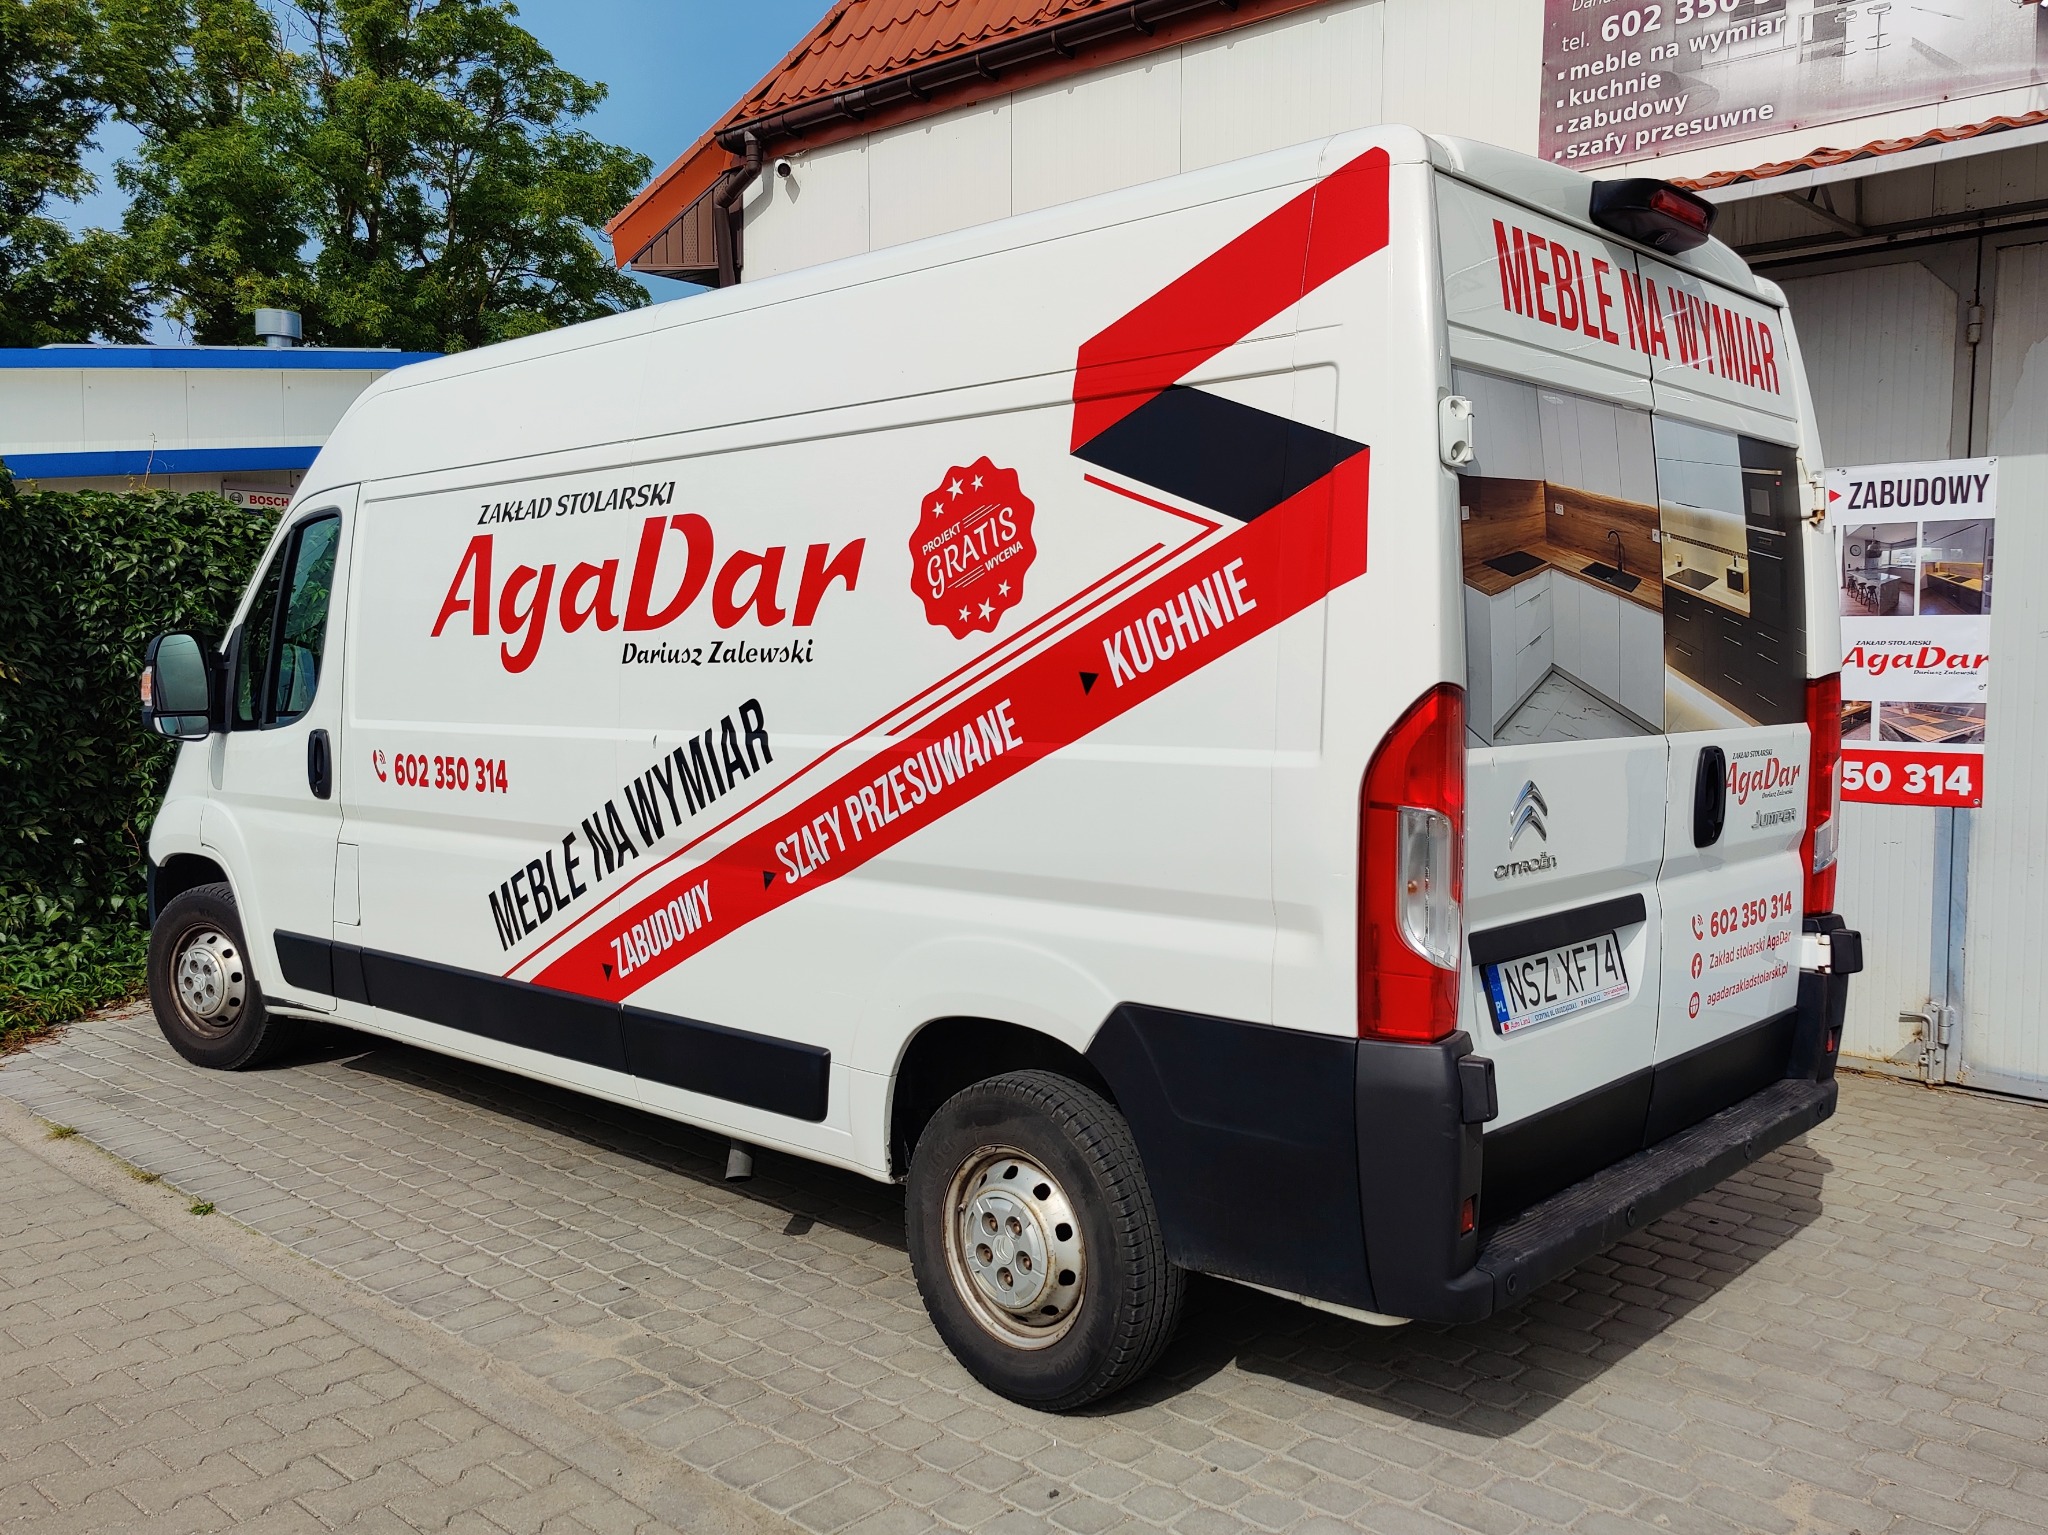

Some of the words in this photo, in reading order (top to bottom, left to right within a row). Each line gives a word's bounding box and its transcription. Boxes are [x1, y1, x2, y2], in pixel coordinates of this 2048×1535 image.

[1561, 31, 1590, 52] tel.
[1601, 4, 1662, 42] 602
[1569, 49, 1642, 81] meble
[1650, 42, 1679, 62] na
[1688, 15, 1787, 54] wymiar
[1569, 72, 1662, 107] kuchnie
[1566, 132, 1627, 159] szafy
[1634, 104, 1774, 150] przesuwne
[1567, 93, 1688, 133] zabudowy
[1492, 218, 1620, 346] MEBLE
[1619, 267, 1671, 361] NA
[1667, 286, 1780, 395] WYMIAR
[249, 494, 289, 507] BOSCH
[476, 492, 553, 526] ZAKŁAD
[555, 481, 676, 517] STOLARSKI
[1847, 473, 1990, 510] ZABUDOWY
[921, 521, 962, 556] PROJEKT
[926, 506, 1017, 600] GRATIS
[984, 541, 1024, 572] WYCENA
[430, 512, 867, 674] AgaDar
[1102, 556, 1258, 689] KUCHNIE
[621, 642, 703, 667] Dariusz
[707, 640, 814, 665] Zalewski
[1842, 646, 1989, 676] AgaDar
[394, 753, 429, 787] 602
[433, 755, 469, 791] 350
[474, 757, 508, 793] 314
[774, 805, 846, 885] SZAFY
[844, 698, 1023, 842] PRZESUWANE
[1726, 757, 1800, 805] AgaDar
[1841, 760, 1892, 792] 50
[1902, 763, 1972, 796] 314
[488, 832, 588, 952] MEBLE
[581, 799, 640, 883] NA
[623, 698, 774, 848] WYMIAR
[610, 879, 713, 979] ZABUDOWY
[1710, 905, 1738, 938] 602
[1741, 897, 1767, 928] 350
[1770, 890, 1792, 920] 314
[1709, 946, 1735, 969] Zakład
[1736, 935, 1766, 960] stolarski
[1766, 930, 1792, 951] AgaDar
[1504, 957, 1557, 1014] NSZ
[1557, 939, 1619, 997] XF74
[1706, 961, 1789, 1006] agadarzakladstolarski.pl
[1496, 1001, 1506, 1014] PL
